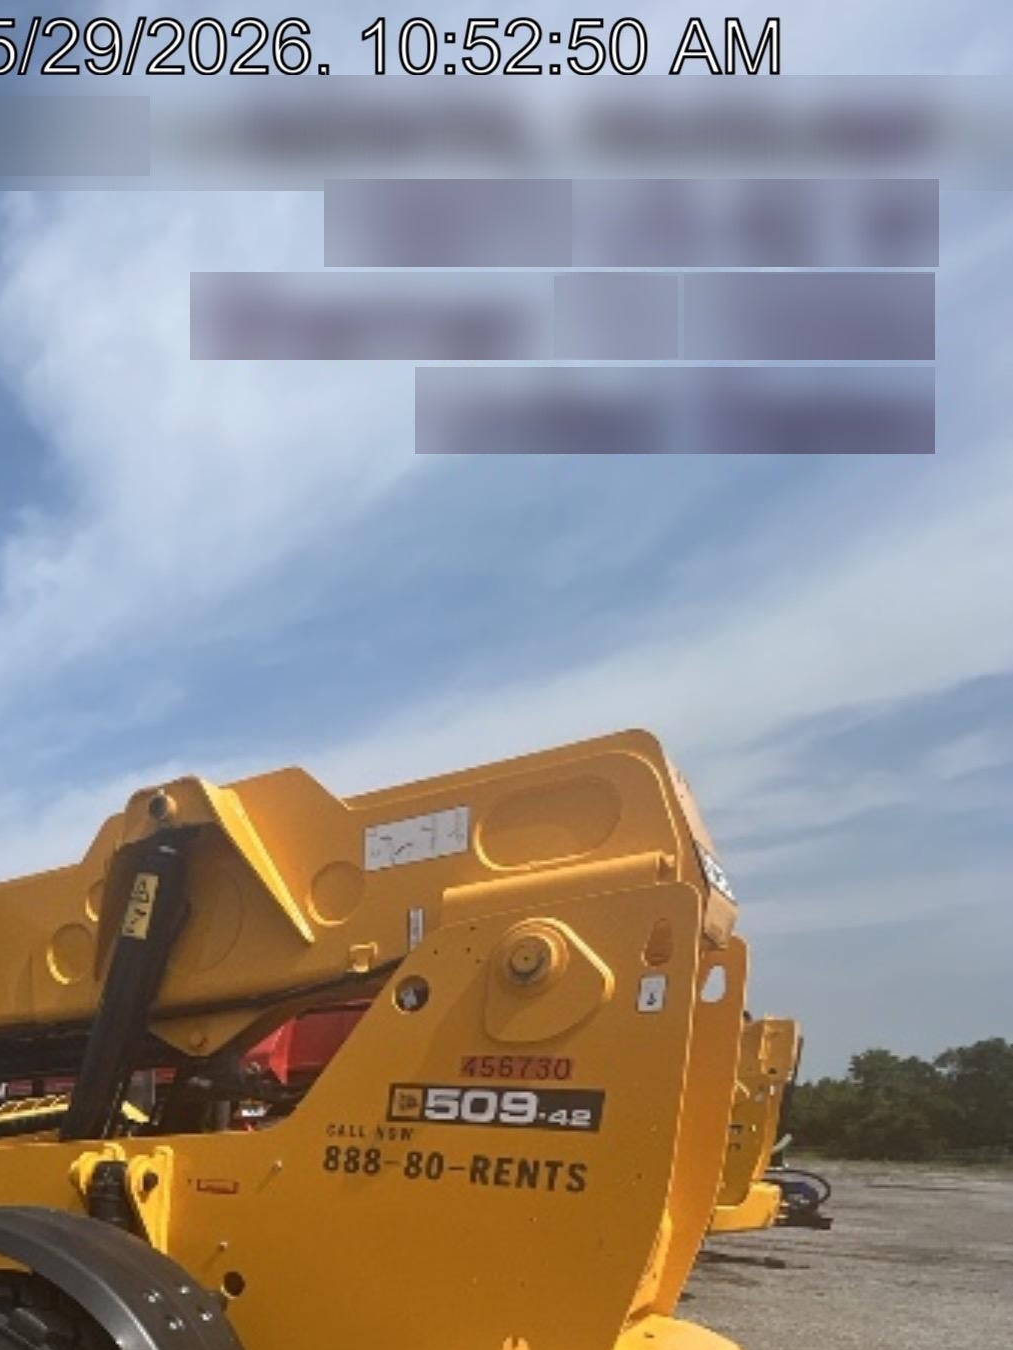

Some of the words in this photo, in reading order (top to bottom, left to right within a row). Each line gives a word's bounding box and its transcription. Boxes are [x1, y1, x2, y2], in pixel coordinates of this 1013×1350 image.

[460, 1055, 572, 1081] 456730
[326, 1123, 365, 1138] CALL
[323, 1145, 588, 1193] 888-80-RENTS
